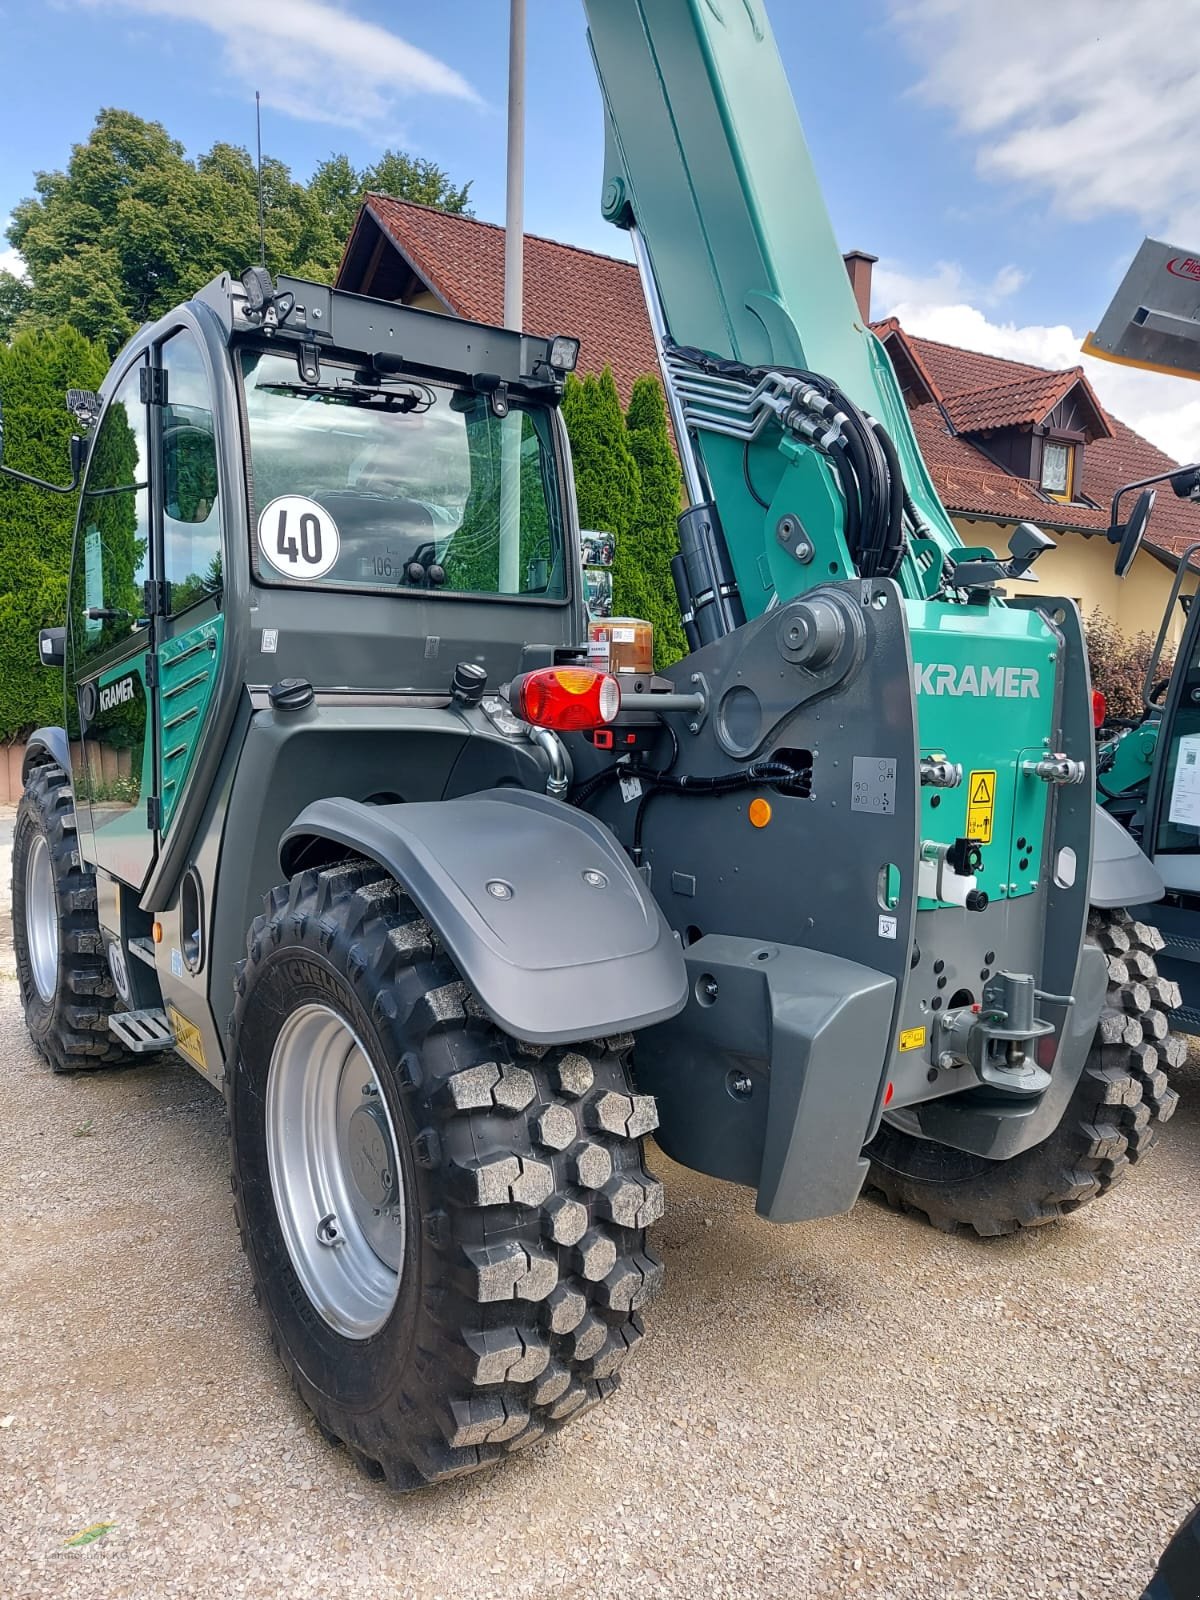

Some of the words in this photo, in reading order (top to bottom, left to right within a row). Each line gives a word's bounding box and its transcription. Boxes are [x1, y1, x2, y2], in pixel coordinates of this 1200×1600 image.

[276, 509, 323, 565] 40
[372, 556, 392, 577] 106
[99, 676, 135, 713] KRAMER
[913, 662, 1040, 699] KRAMER
